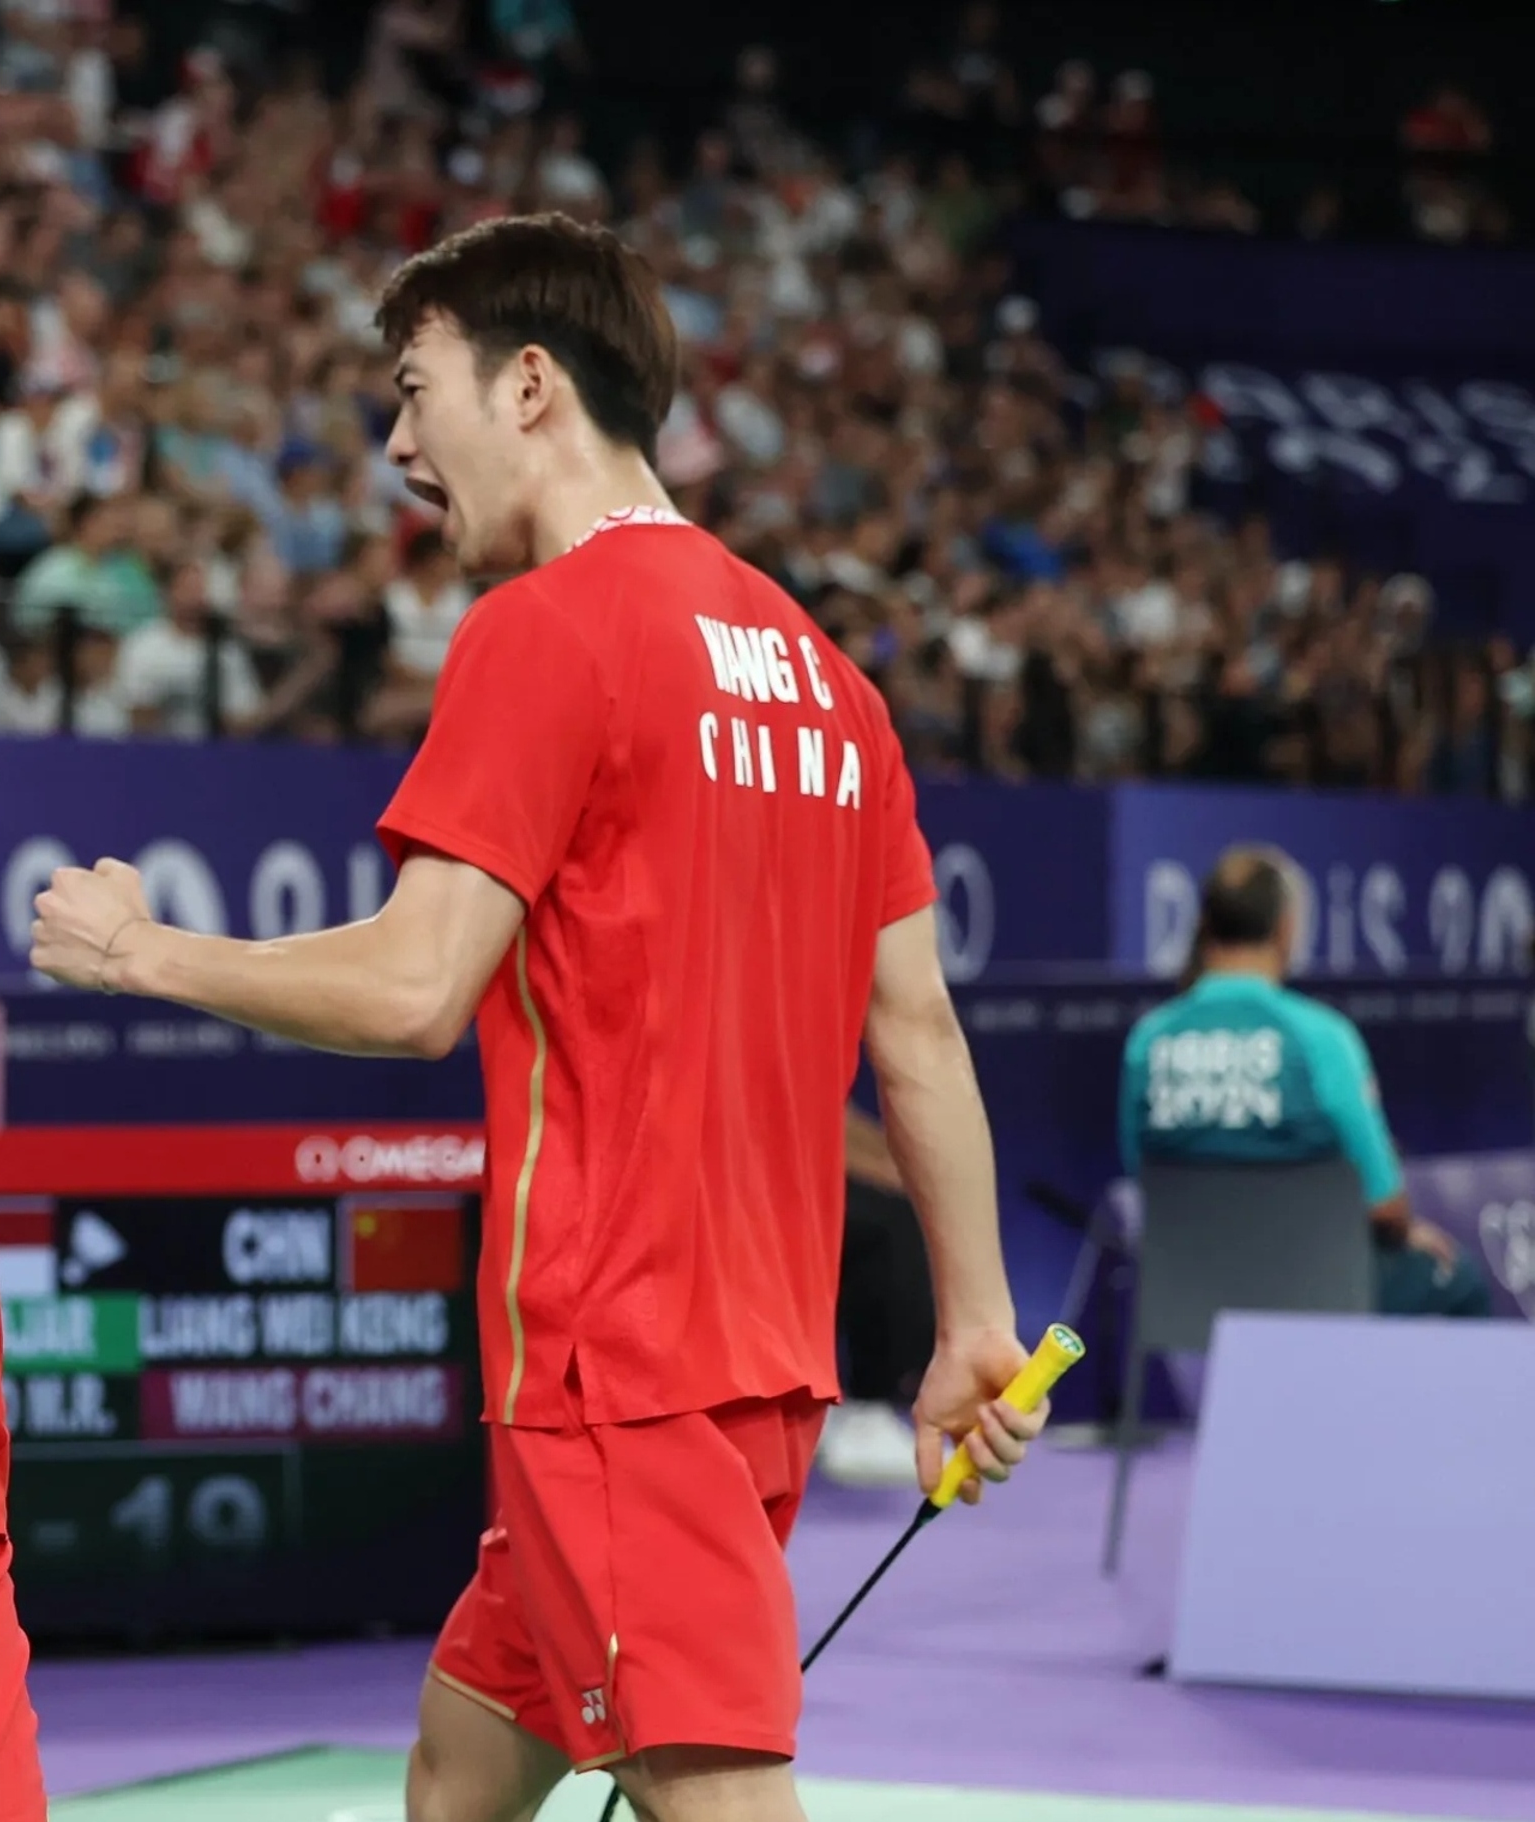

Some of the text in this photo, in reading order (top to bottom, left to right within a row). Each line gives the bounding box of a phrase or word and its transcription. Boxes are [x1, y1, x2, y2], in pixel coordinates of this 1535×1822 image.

[797, 634, 834, 711] C
[699, 711, 861, 811] CHINA
[223, 1209, 331, 1283] CHN
[139, 1297, 257, 1357] LIANG
[263, 1296, 335, 1355] WEI
[340, 1293, 447, 1354] KENG
[170, 1370, 294, 1429] WANG
[303, 1366, 447, 1428] CHANG
